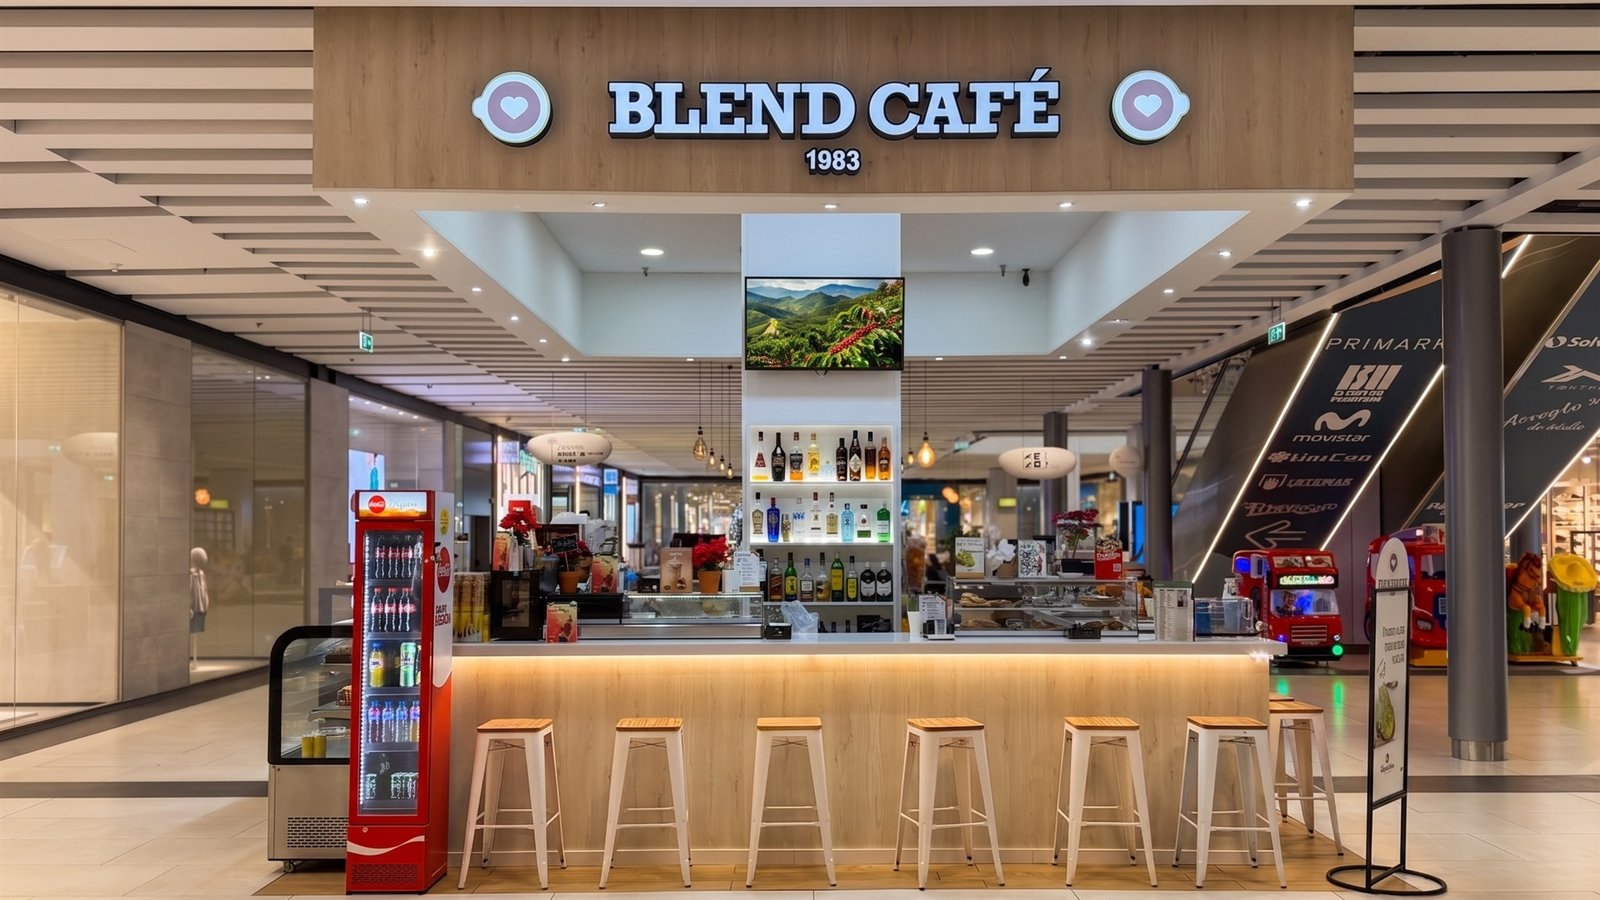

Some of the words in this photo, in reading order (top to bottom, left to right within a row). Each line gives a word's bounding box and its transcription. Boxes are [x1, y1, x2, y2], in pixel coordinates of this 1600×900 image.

[608, 81, 856, 138] BLEND
[868, 67, 1060, 138] CAFÉ
[805, 149, 861, 175] 1983
[1292, 434, 1371, 443] movistar
